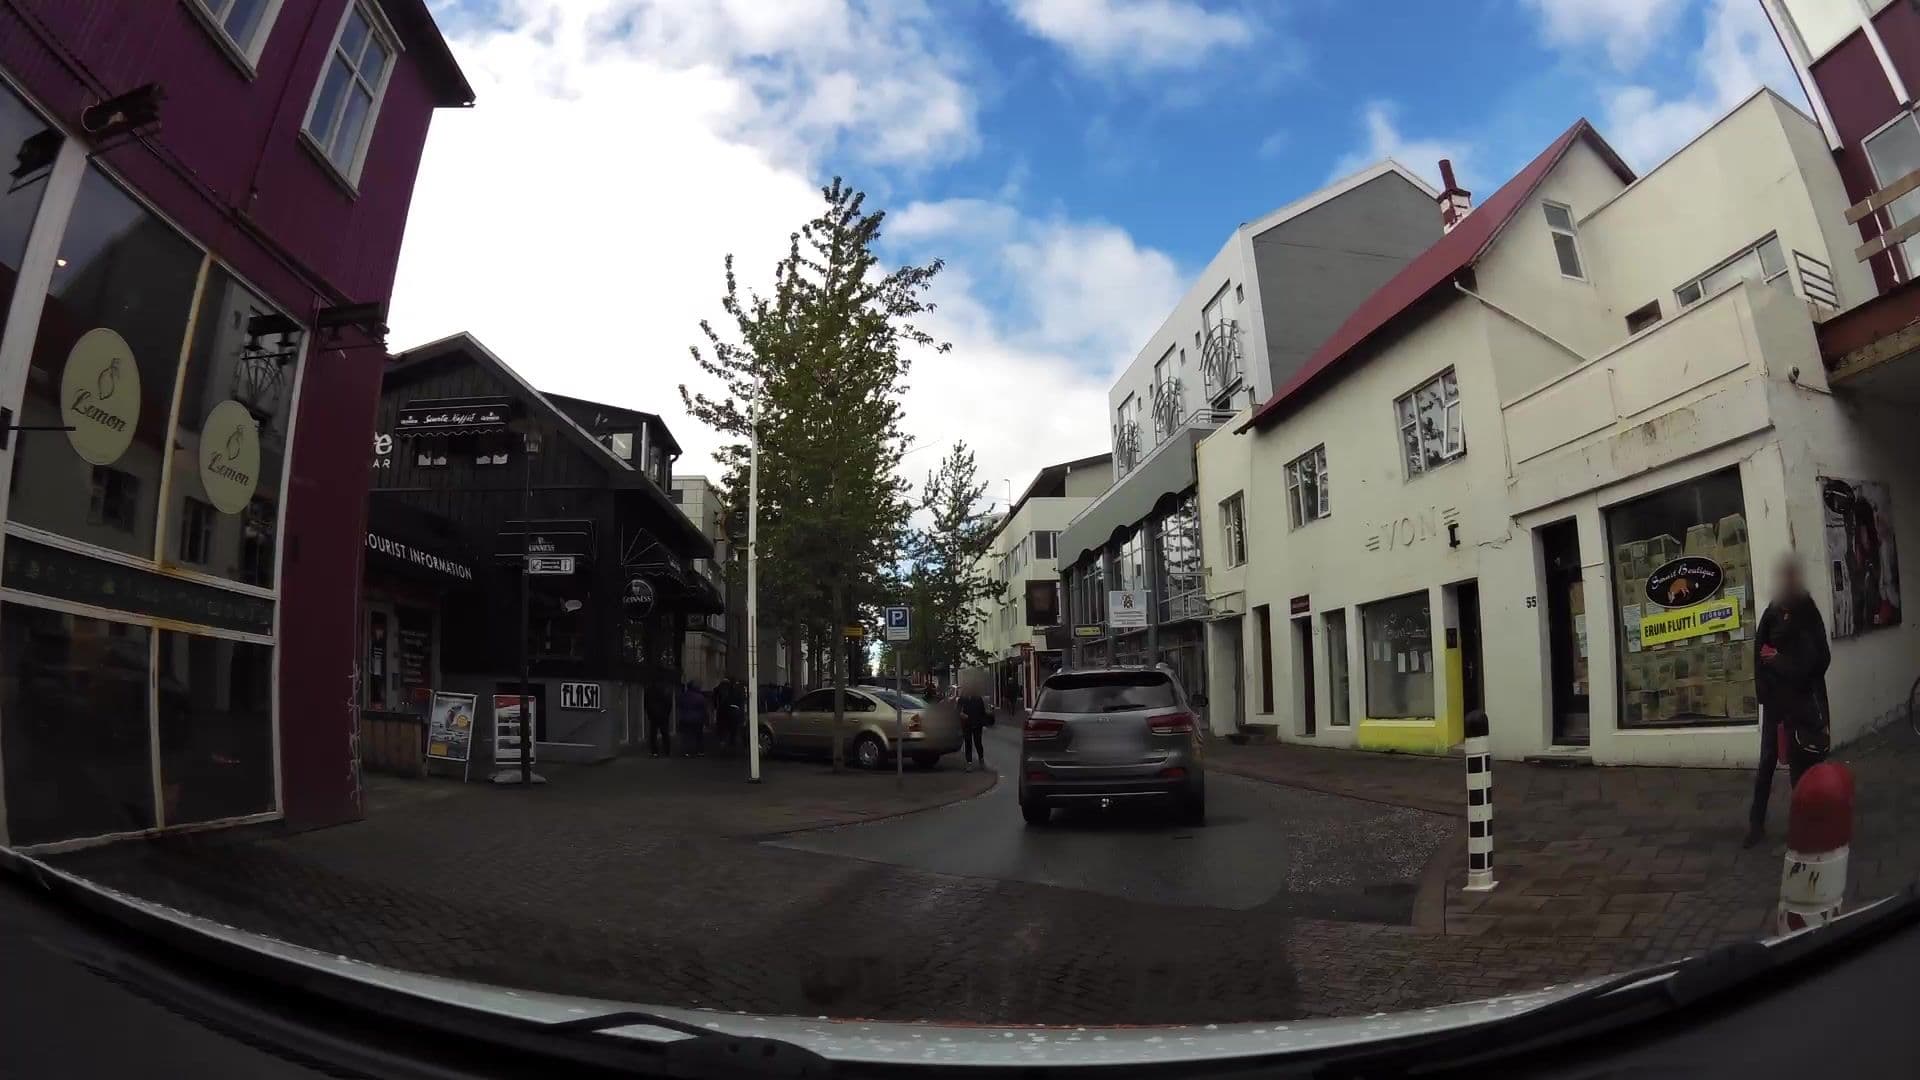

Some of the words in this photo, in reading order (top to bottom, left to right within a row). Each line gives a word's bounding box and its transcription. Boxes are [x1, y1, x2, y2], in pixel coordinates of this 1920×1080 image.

[72, 388, 127, 432] Lemon
[208, 450, 249, 487] Lemon
[409, 547, 473, 580] INFORMATION
[1526, 596, 1537, 609] 55
[891, 610, 905, 626] P
[1644, 620, 1667, 637] ERUM
[1667, 615, 1691, 632] FLUTT
[562, 684, 599, 708] FLASH
